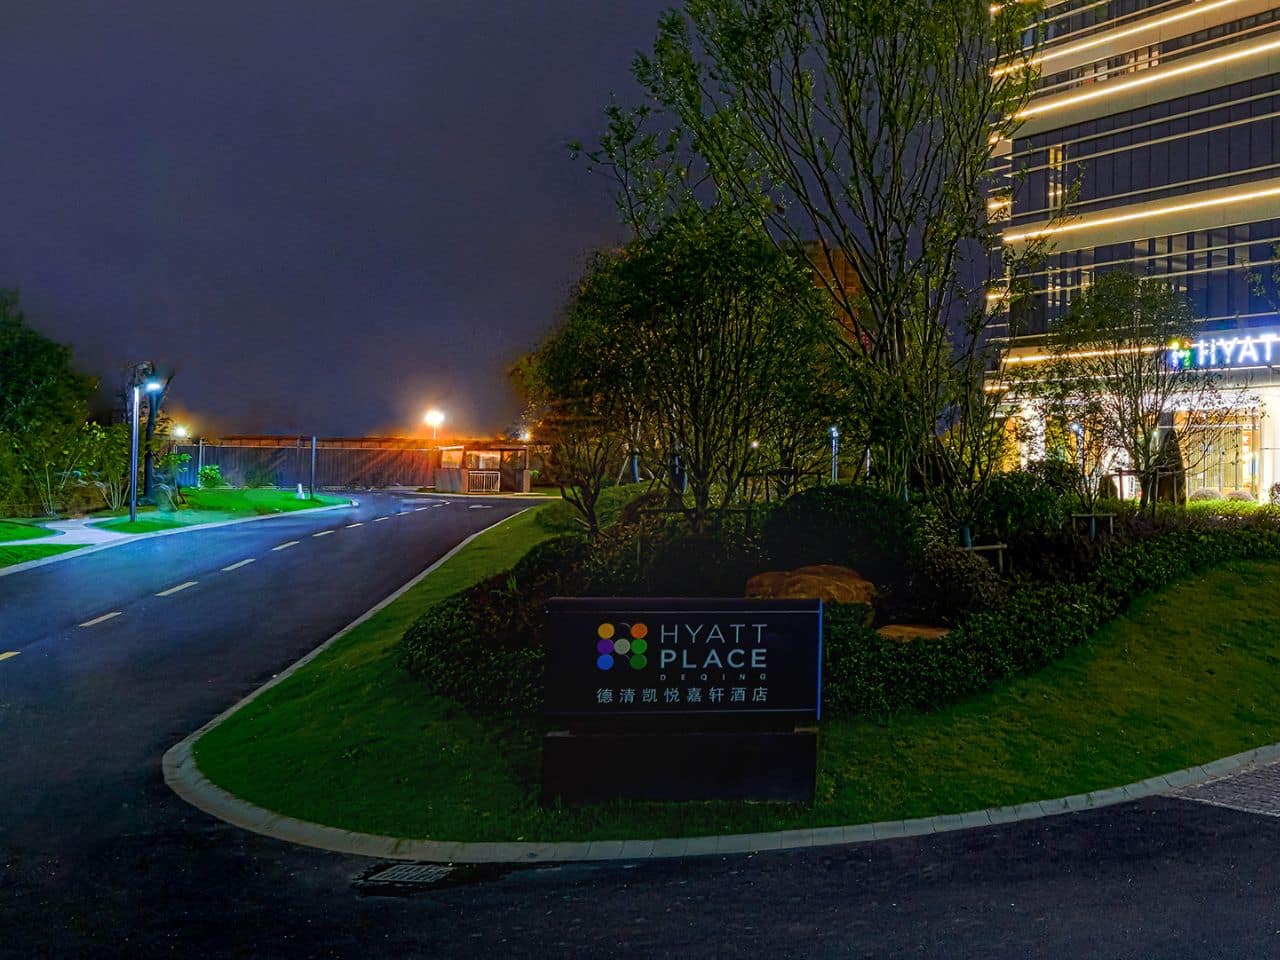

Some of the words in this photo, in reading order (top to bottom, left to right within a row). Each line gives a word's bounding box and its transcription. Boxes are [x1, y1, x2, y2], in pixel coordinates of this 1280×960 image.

[659, 623, 769, 644] HYATT
[659, 648, 769, 669] PLACE
[659, 672, 768, 681] DEQING
[596, 686, 769, 704] 德清凯悦嘉轩酒店
